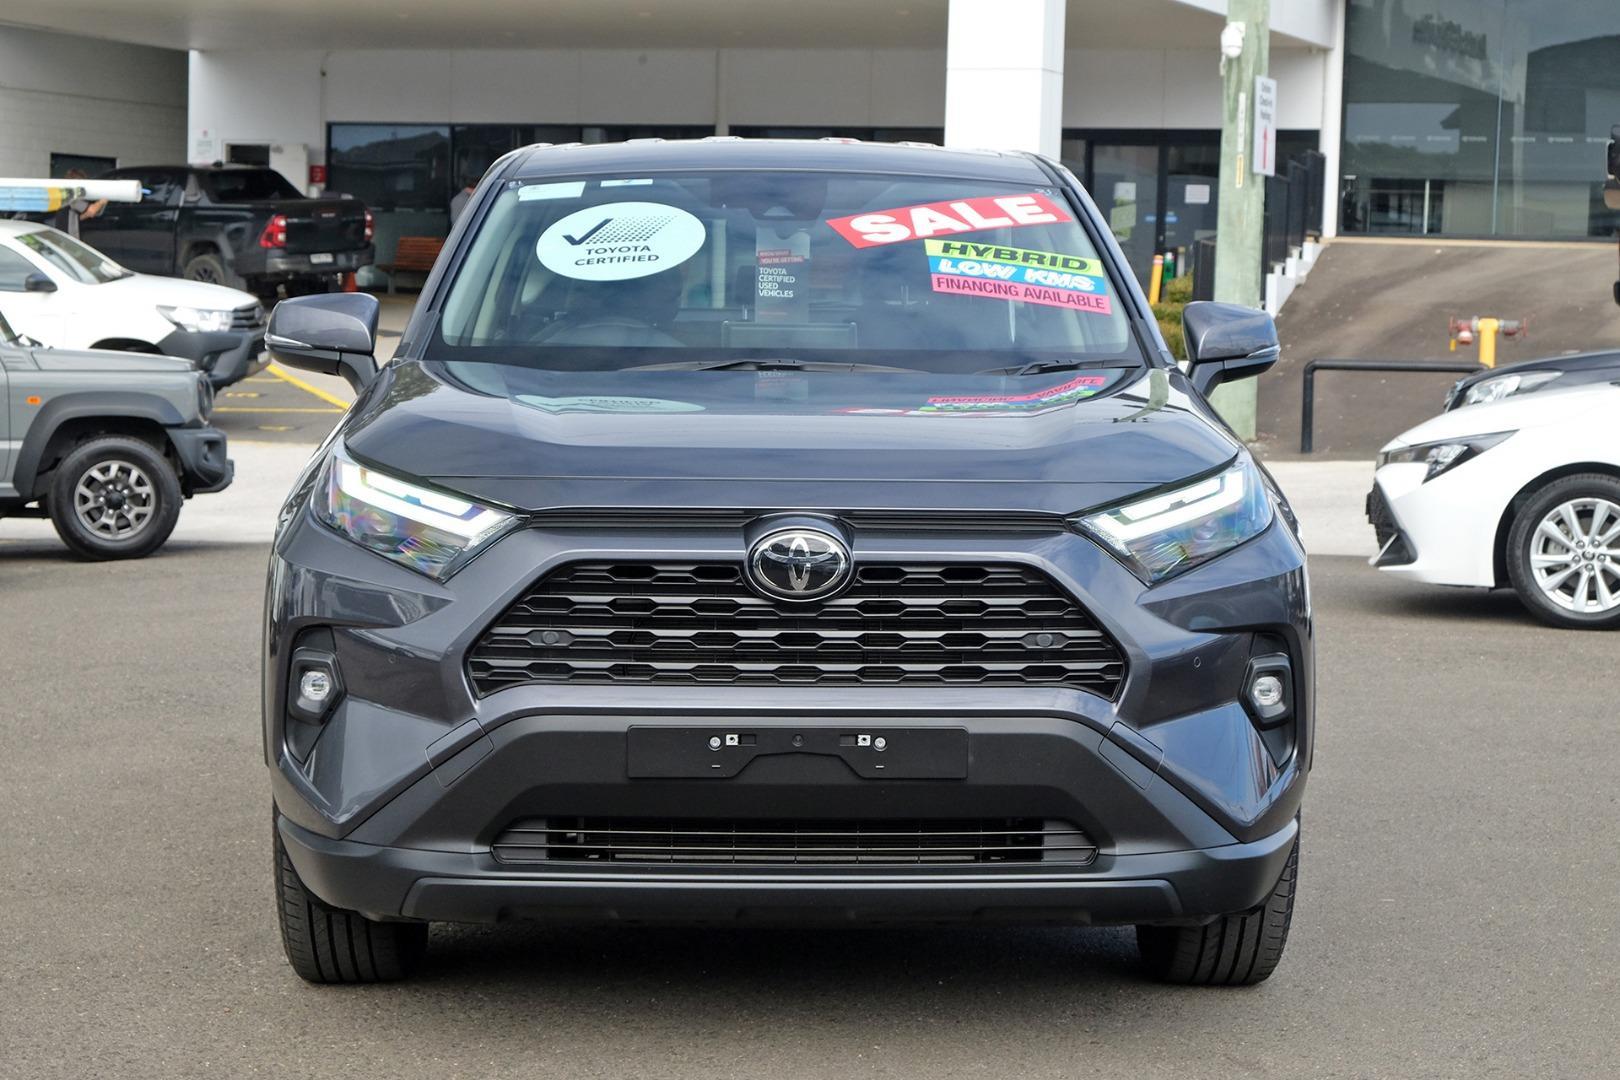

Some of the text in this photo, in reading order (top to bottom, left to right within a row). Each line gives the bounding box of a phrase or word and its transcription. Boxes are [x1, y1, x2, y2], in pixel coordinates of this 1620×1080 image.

[850, 196, 1057, 243] SALE
[574, 254, 660, 266] CERTIFIED
[586, 245, 651, 255] TOYOTA
[942, 242, 1088, 270] HYBRID
[758, 275, 796, 283] CERTIFIED
[759, 267, 787, 275] TOYOTA
[938, 258, 1096, 292] LOW KMS
[936, 277, 1105, 309] FINANCING AVAILABLE
